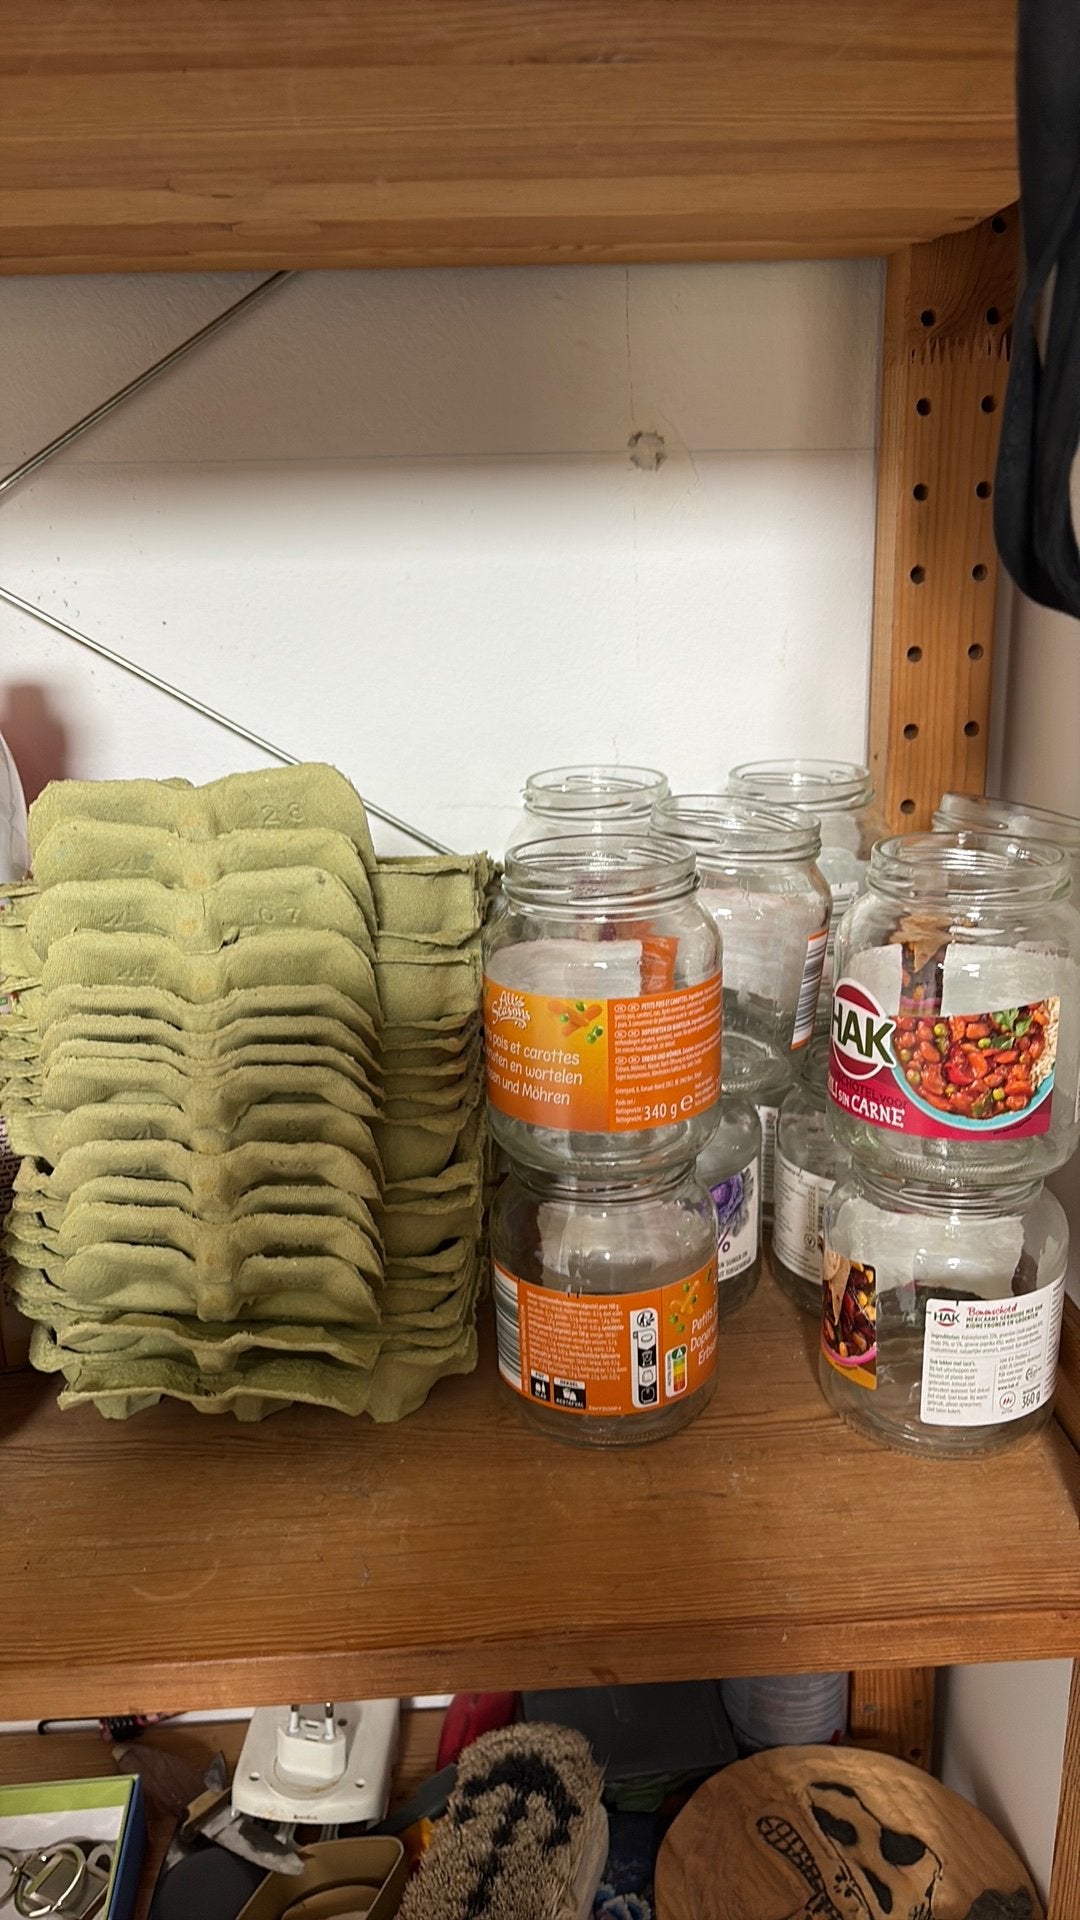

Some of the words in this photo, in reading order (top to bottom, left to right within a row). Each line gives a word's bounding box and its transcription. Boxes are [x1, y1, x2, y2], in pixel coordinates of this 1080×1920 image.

[831, 998, 894, 1065] HAK
[492, 1034, 509, 1051] pois
[510, 1041, 521, 1055] et
[523, 1046, 580, 1065] carottes
[510, 1061, 522, 1074] en
[525, 1066, 583, 1085] wortelen
[502, 1078, 519, 1094] und
[522, 1082, 570, 1106] Möhren
[644, 1102, 667, 1121] 340
[670, 1103, 677, 1119] g
[681, 1094, 693, 1111] e
[851, 1094, 905, 1128] CARNE
[934, 1311, 960, 1323] HAK
[1021, 1391, 1035, 1409] 360
[1036, 1390, 1041, 1404] g
